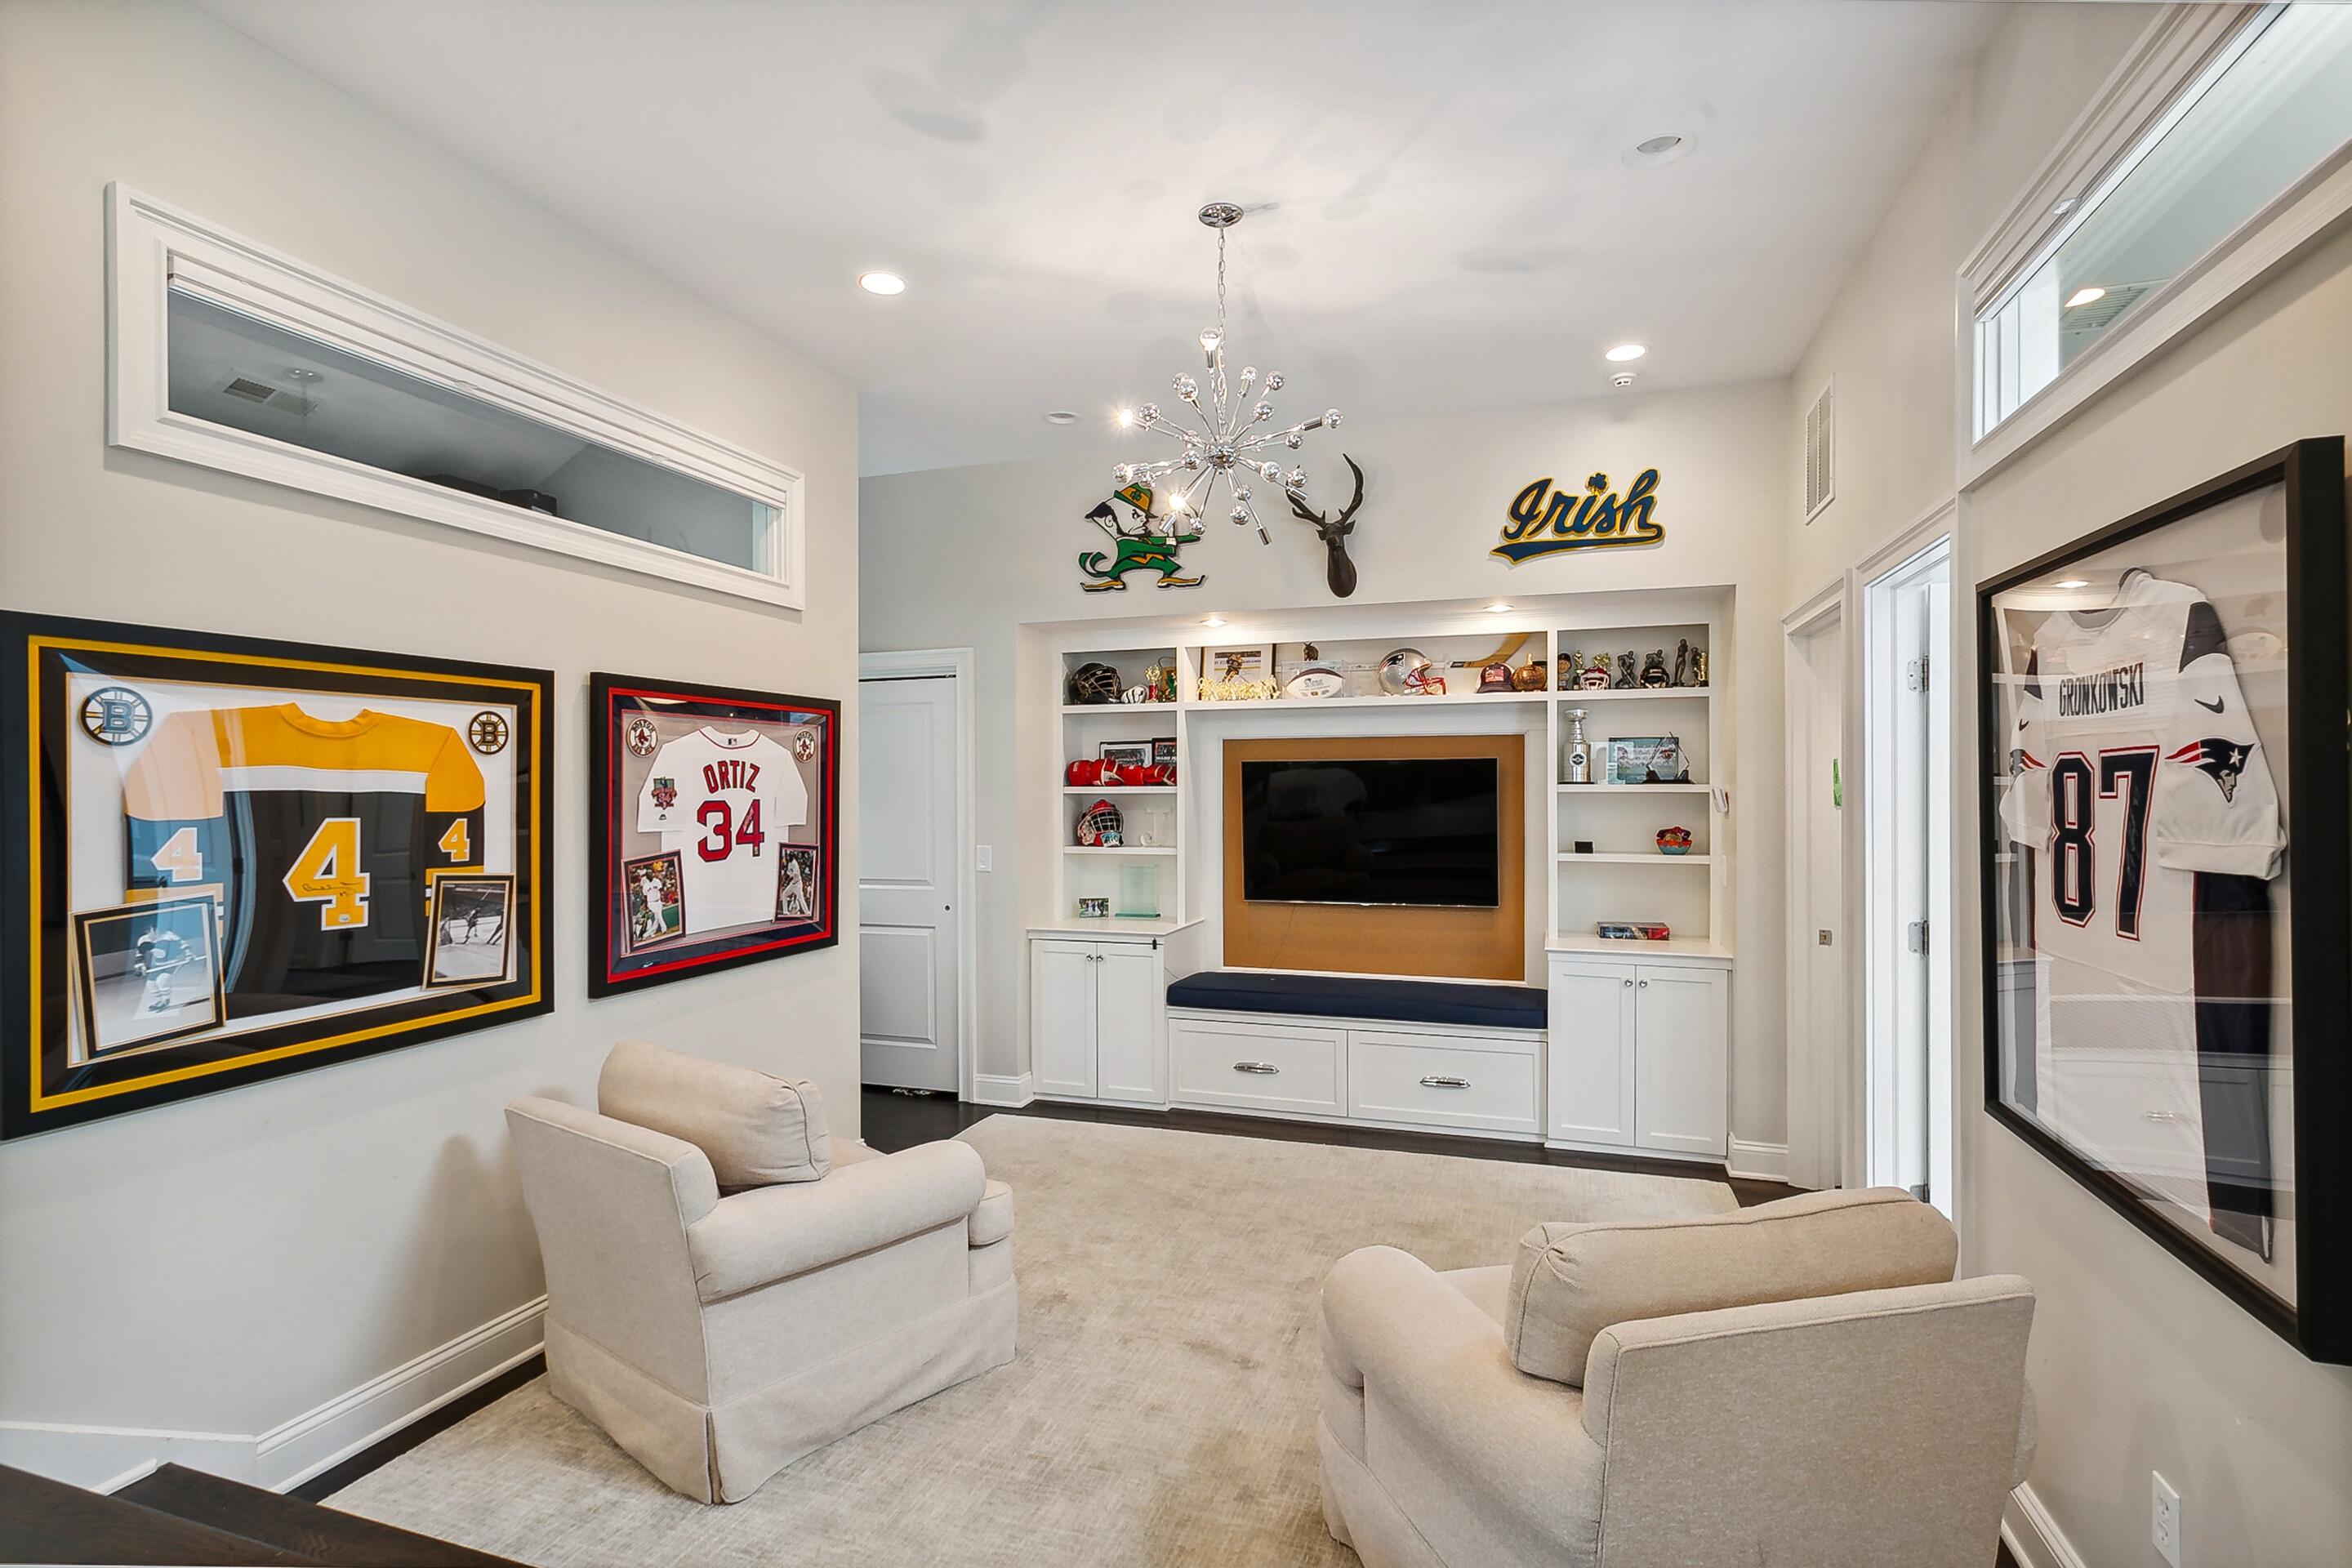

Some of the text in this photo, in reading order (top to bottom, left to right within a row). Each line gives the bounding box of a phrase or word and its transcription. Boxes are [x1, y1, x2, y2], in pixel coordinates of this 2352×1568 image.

[1501, 467, 1666, 542] Irish
[101, 699, 136, 733] B
[2059, 662, 2145, 717] GRONKOWSKI
[481, 720, 498, 745] B
[702, 760, 760, 794] ORTIZ
[150, 827, 203, 882] 4
[438, 818, 470, 862] 4
[697, 799, 764, 862] 34
[2051, 744, 2160, 942] 87
[282, 817, 370, 931] 4
